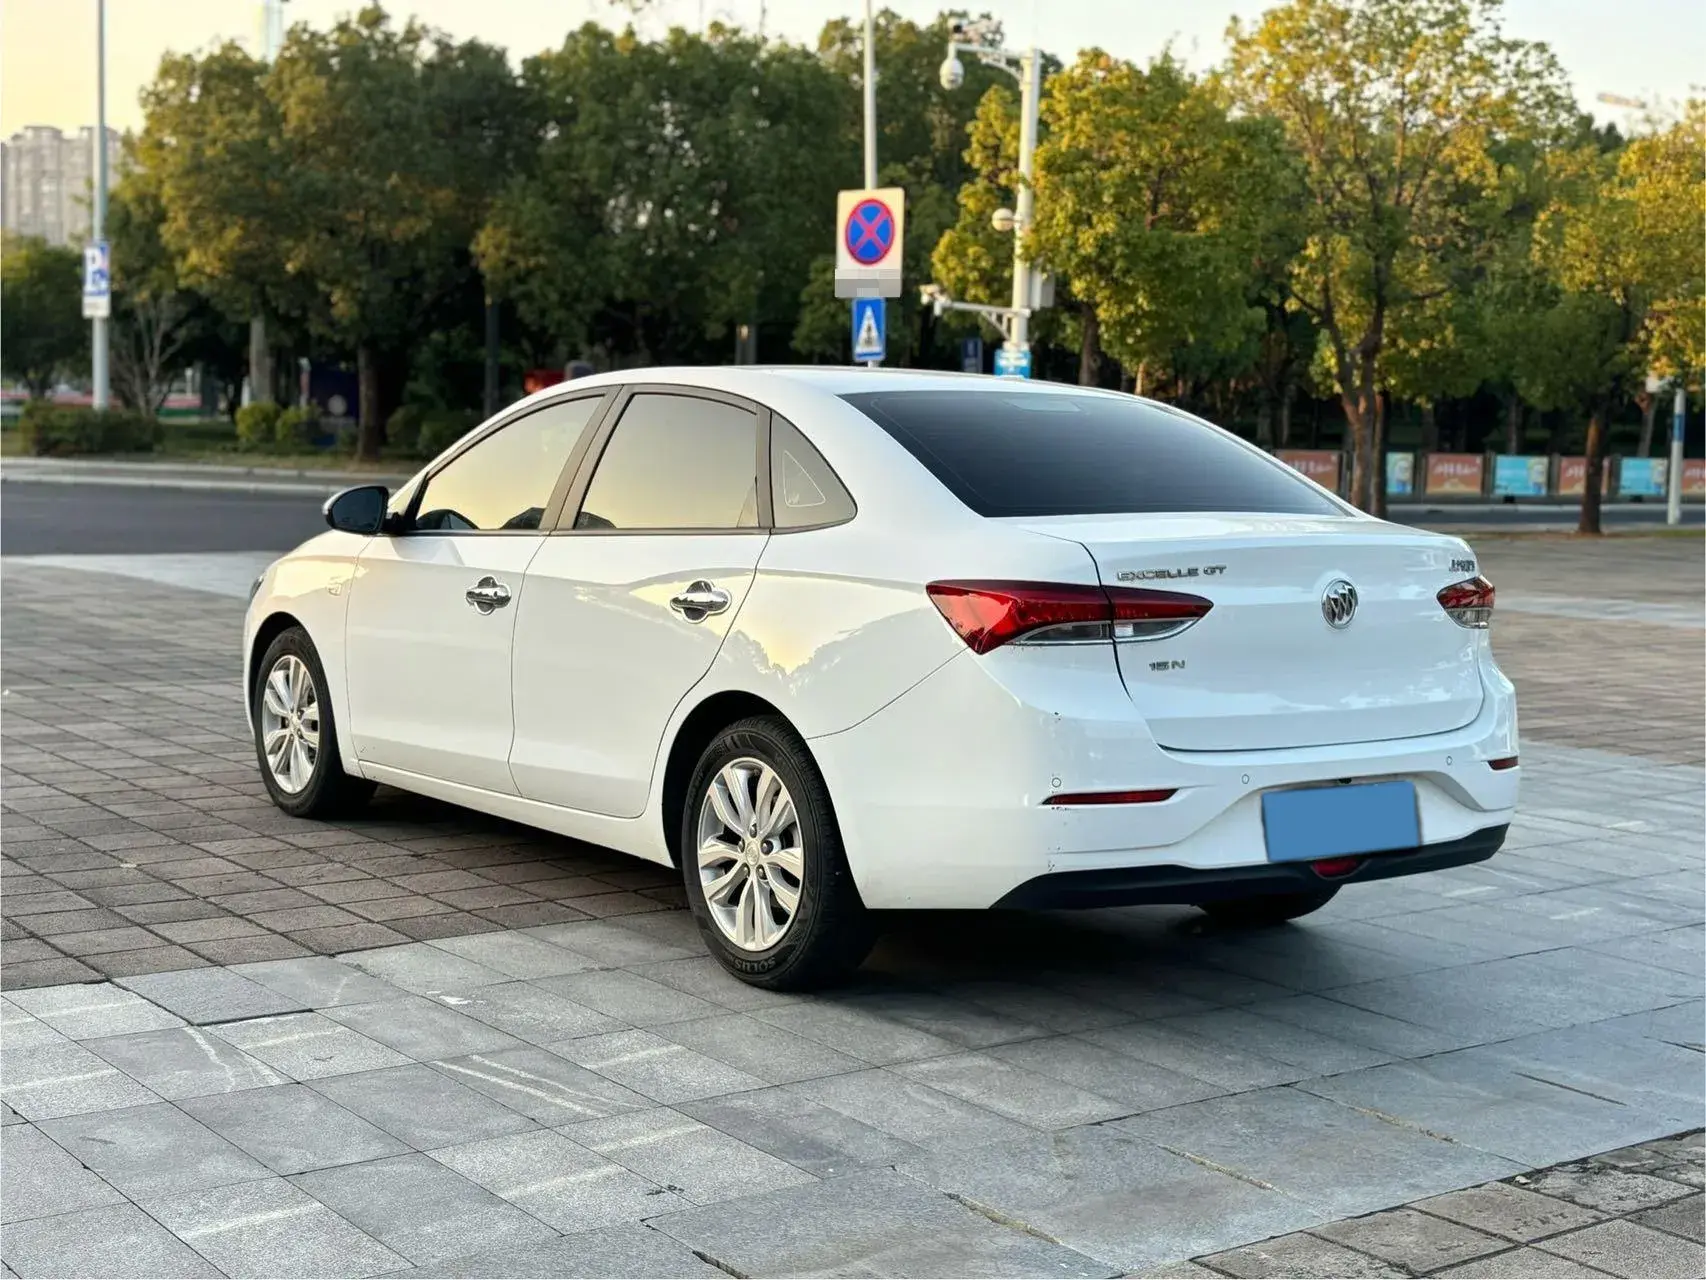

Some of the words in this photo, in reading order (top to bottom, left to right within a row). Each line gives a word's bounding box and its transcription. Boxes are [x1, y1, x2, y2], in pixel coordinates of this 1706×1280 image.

[1117, 568, 1199, 582] EXCELLE
[1203, 564, 1227, 576] GT
[734, 957, 776, 973] SOLUS
